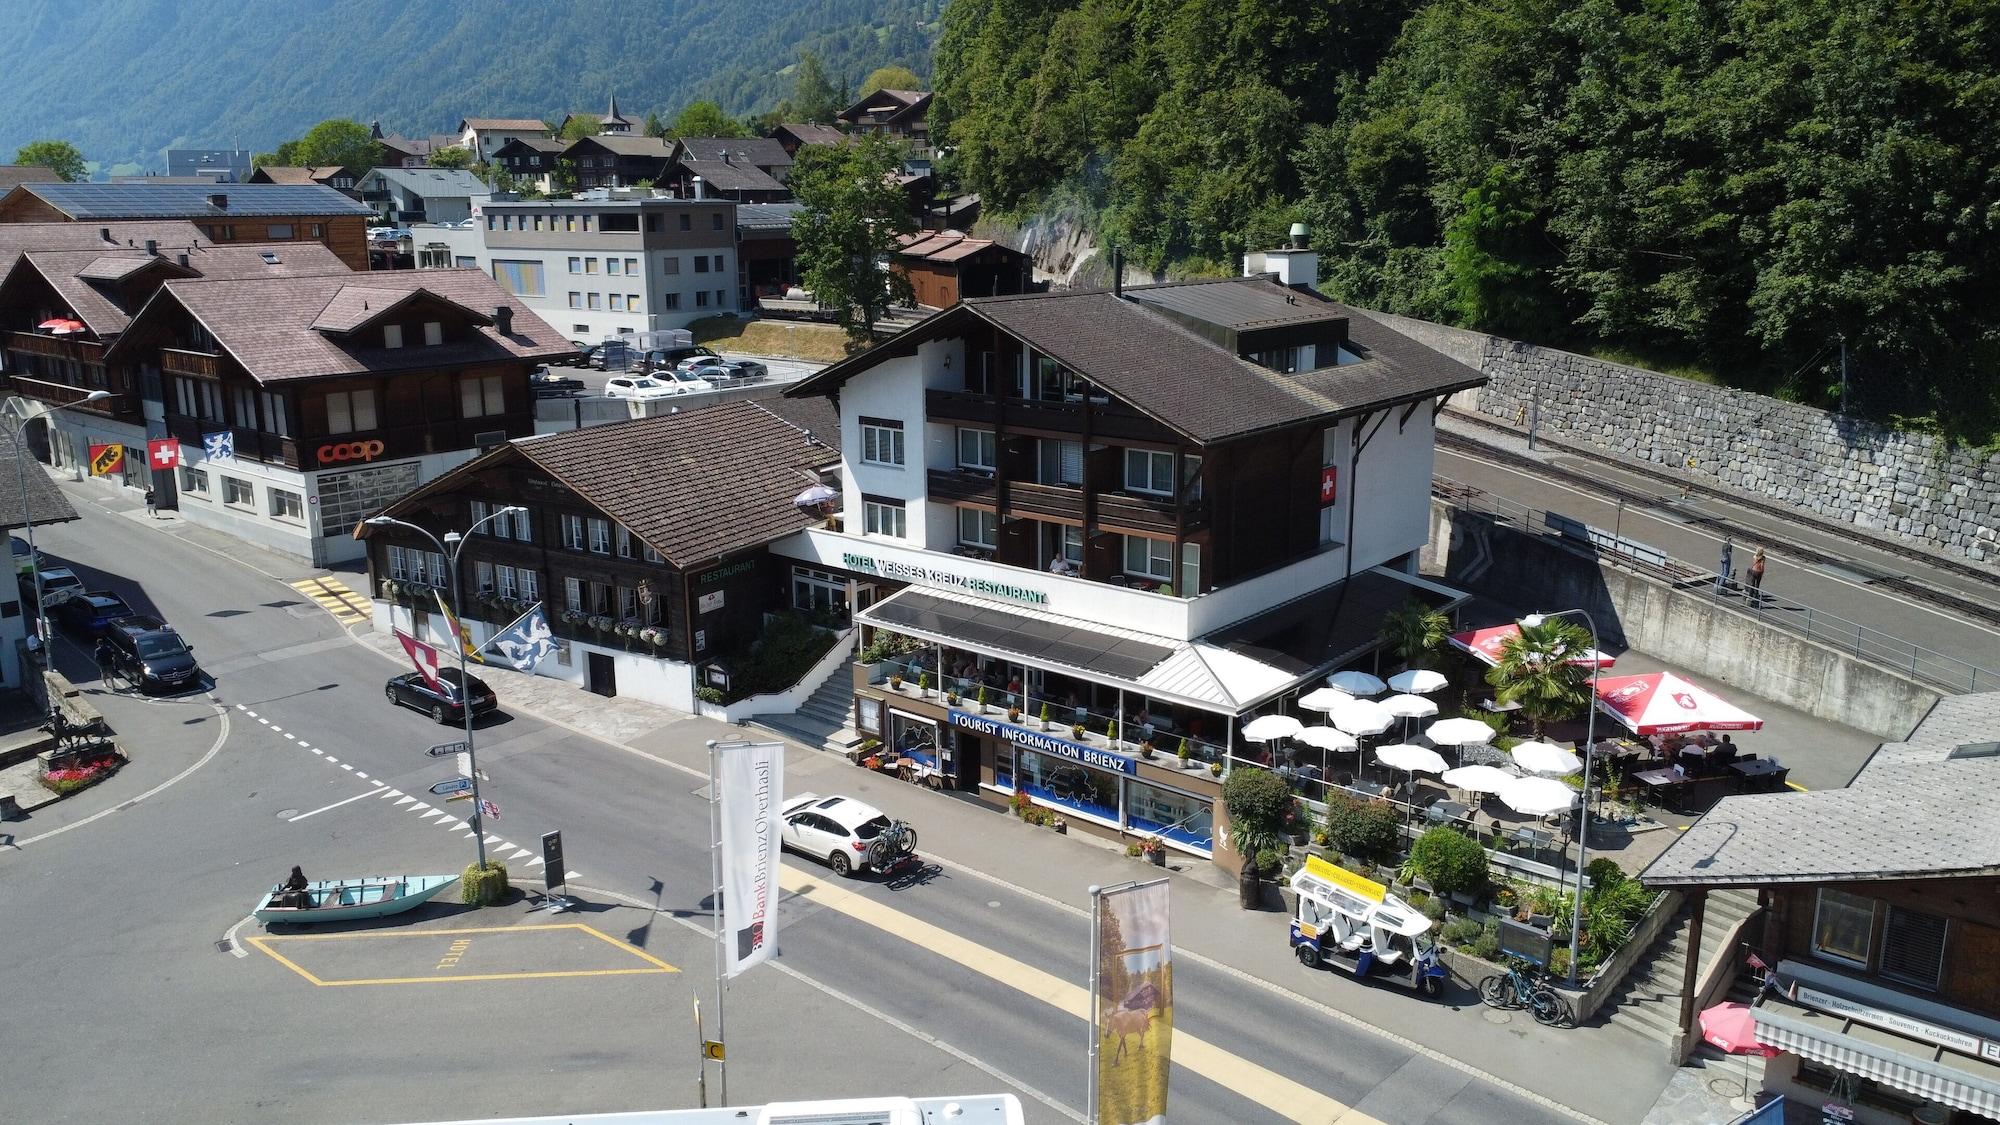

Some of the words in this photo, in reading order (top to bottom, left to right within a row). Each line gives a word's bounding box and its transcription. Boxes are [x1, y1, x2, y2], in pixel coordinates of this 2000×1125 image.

[317, 439, 384, 463] coop
[700, 559, 756, 584] RESTAURANT
[843, 552, 877, 569] HOTEL
[878, 559, 926, 579] WEISSES
[928, 569, 967, 588] KREUZ
[969, 577, 1047, 604] RESTAURANT
[953, 713, 999, 735] TOURIST
[1001, 727, 1079, 759] INFORMATION
[1083, 751, 1125, 772] BRIENZ
[752, 760, 769, 920] BankBrienzOberhasli
[436, 939, 472, 969] HOTEL
[1803, 991, 1828, 1006] Brienzer
[1888, 1017, 1919, 1033] Souvenirs
[1924, 1028, 1973, 1048] Kuckucksuhren
[710, 1044, 720, 1058] C
